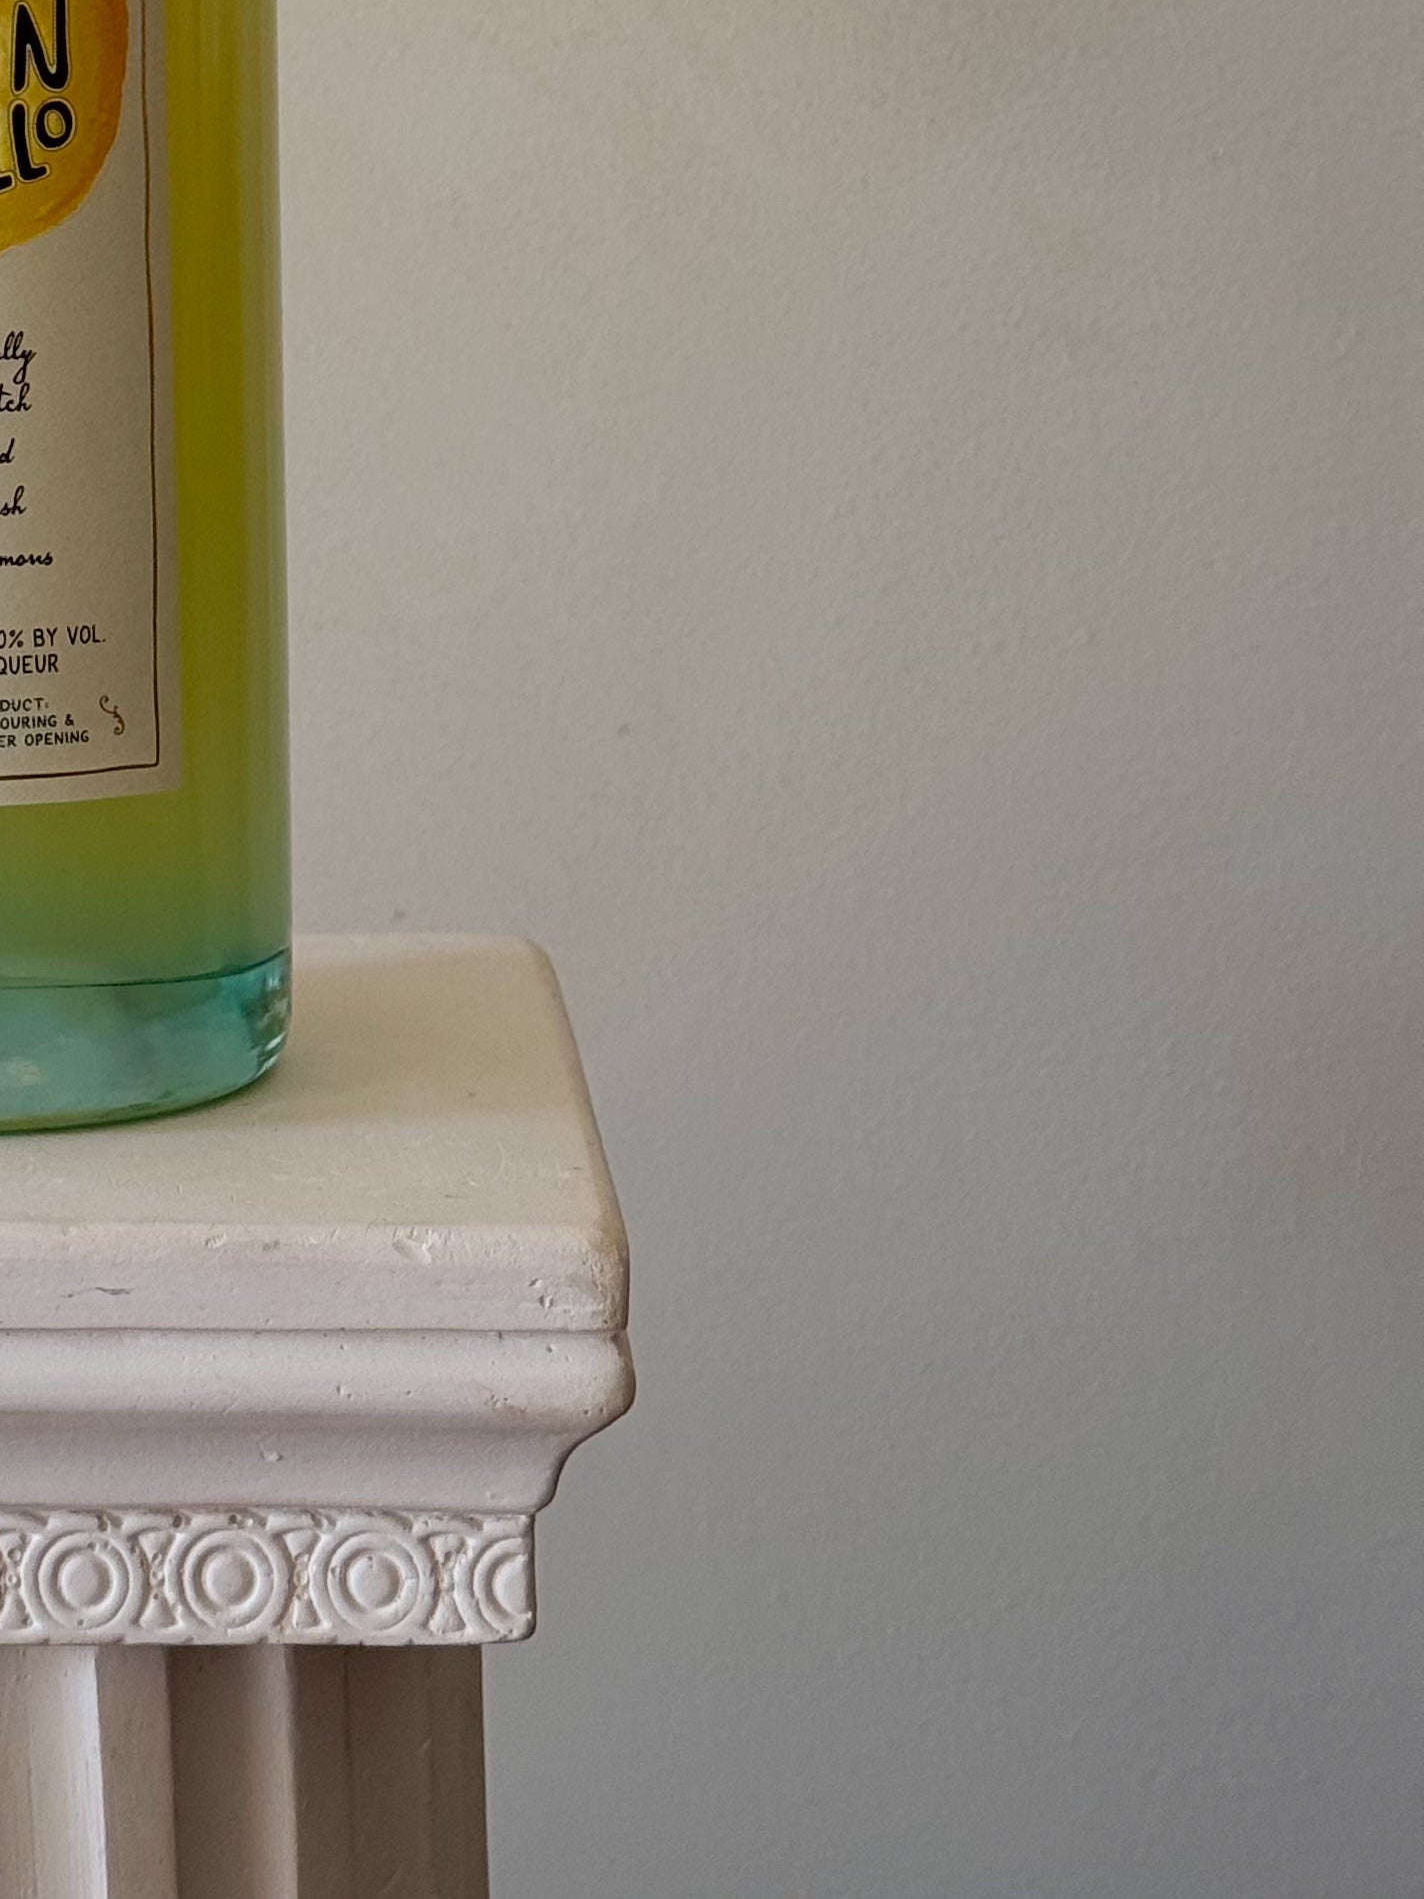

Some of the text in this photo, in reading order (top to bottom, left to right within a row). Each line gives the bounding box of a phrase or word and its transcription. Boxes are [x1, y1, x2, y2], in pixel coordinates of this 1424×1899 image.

[33, 627, 58, 648] BY
[67, 625, 106, 646] VOL.
[65, 713, 75, 727] &
[24, 730, 90, 747] OPENING
